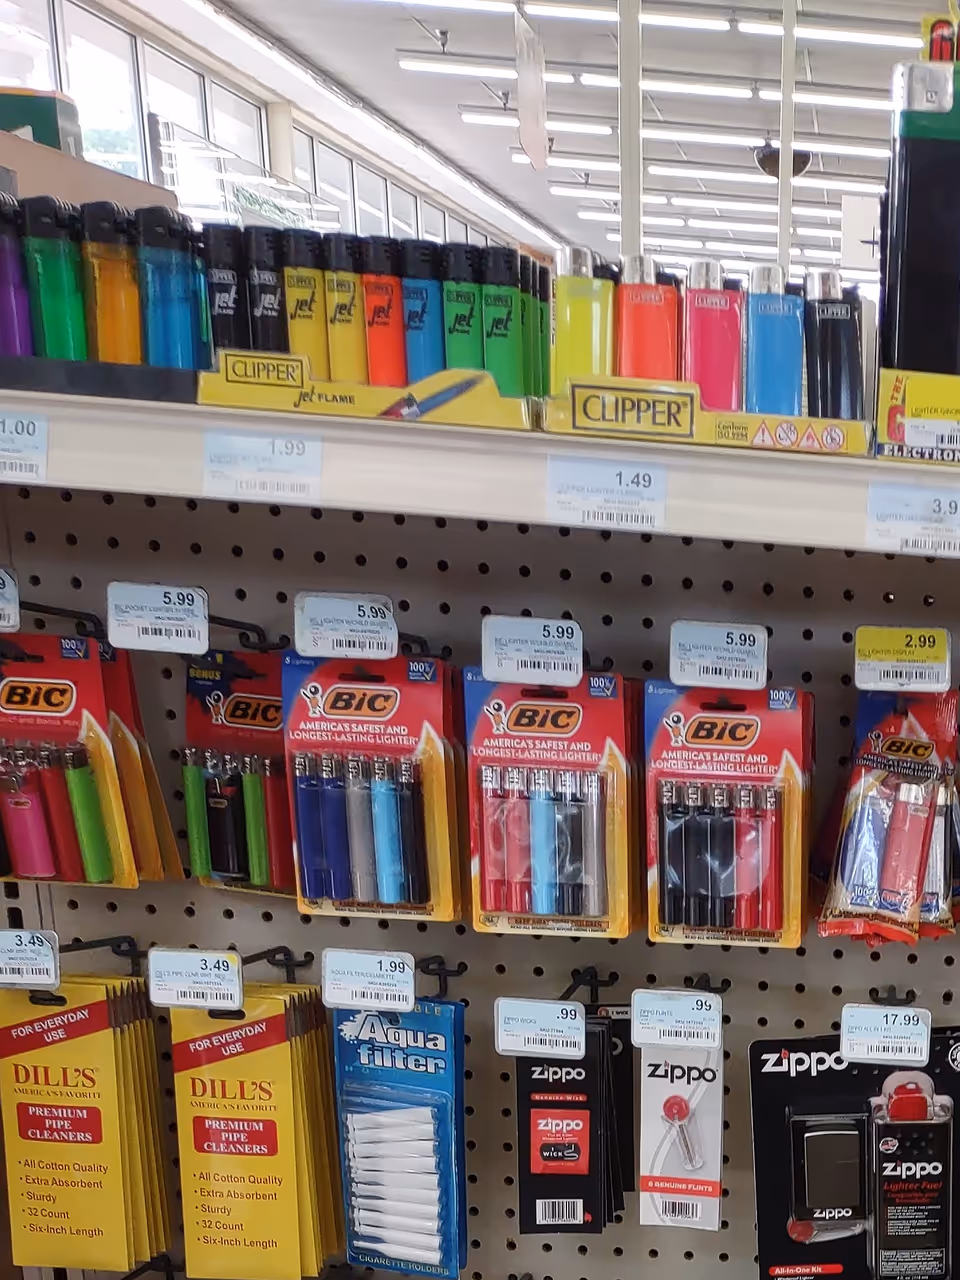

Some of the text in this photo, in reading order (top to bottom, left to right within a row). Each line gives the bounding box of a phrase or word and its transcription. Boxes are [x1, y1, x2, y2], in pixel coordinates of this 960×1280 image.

[232, 360, 298, 382] CLIPPER
[295, 387, 355, 407] jet FLAME
[583, 395, 682, 427] CLIPPER
[0, 419, 36, 437] 1.00
[269, 439, 306, 457] 1.99
[615, 471, 651, 489] 1.49
[163, 592, 195, 606] 5.99
[543, 625, 574, 639] 5.99
[725, 631, 756, 647] 5.99
[905, 635, 936, 649] 2.99
[483, 738, 591, 751] AMERICA'S SAFEST AND
[473, 747, 557, 761] LONGEST-LASTING
[199, 958, 230, 973] 3.49
[376, 959, 406, 974] 1.99
[557, 1008, 577, 1020] .99
[883, 1013, 920, 1027] 17.99
[11, 1009, 90, 1039] FOR EVERYDAY
[44, 1029, 67, 1043] USE
[358, 1015, 446, 1053] Aqua
[357, 1043, 445, 1074] filter
[12, 1063, 97, 1088] DILL'S
[28, 1106, 87, 1119] PREMIUM
[45, 1119, 72, 1130] PIPE
[28, 1129, 93, 1142] CLEANERS
[24, 1159, 108, 1175] All Cotton Quality
[25, 1175, 103, 1189] Extra Absorbent
[655, 1181, 712, 1192] GENUINE FLINTS
[883, 1182, 942, 1191] Lighter Fuel
[26, 1191, 57, 1204] Sturdy
[27, 1207, 70, 1220] 32 Count
[29, 1224, 103, 1238] Six-Inch Length
[358, 1254, 407, 1269] CIGARETTE
[775, 1267, 810, 1275] All-In-One
